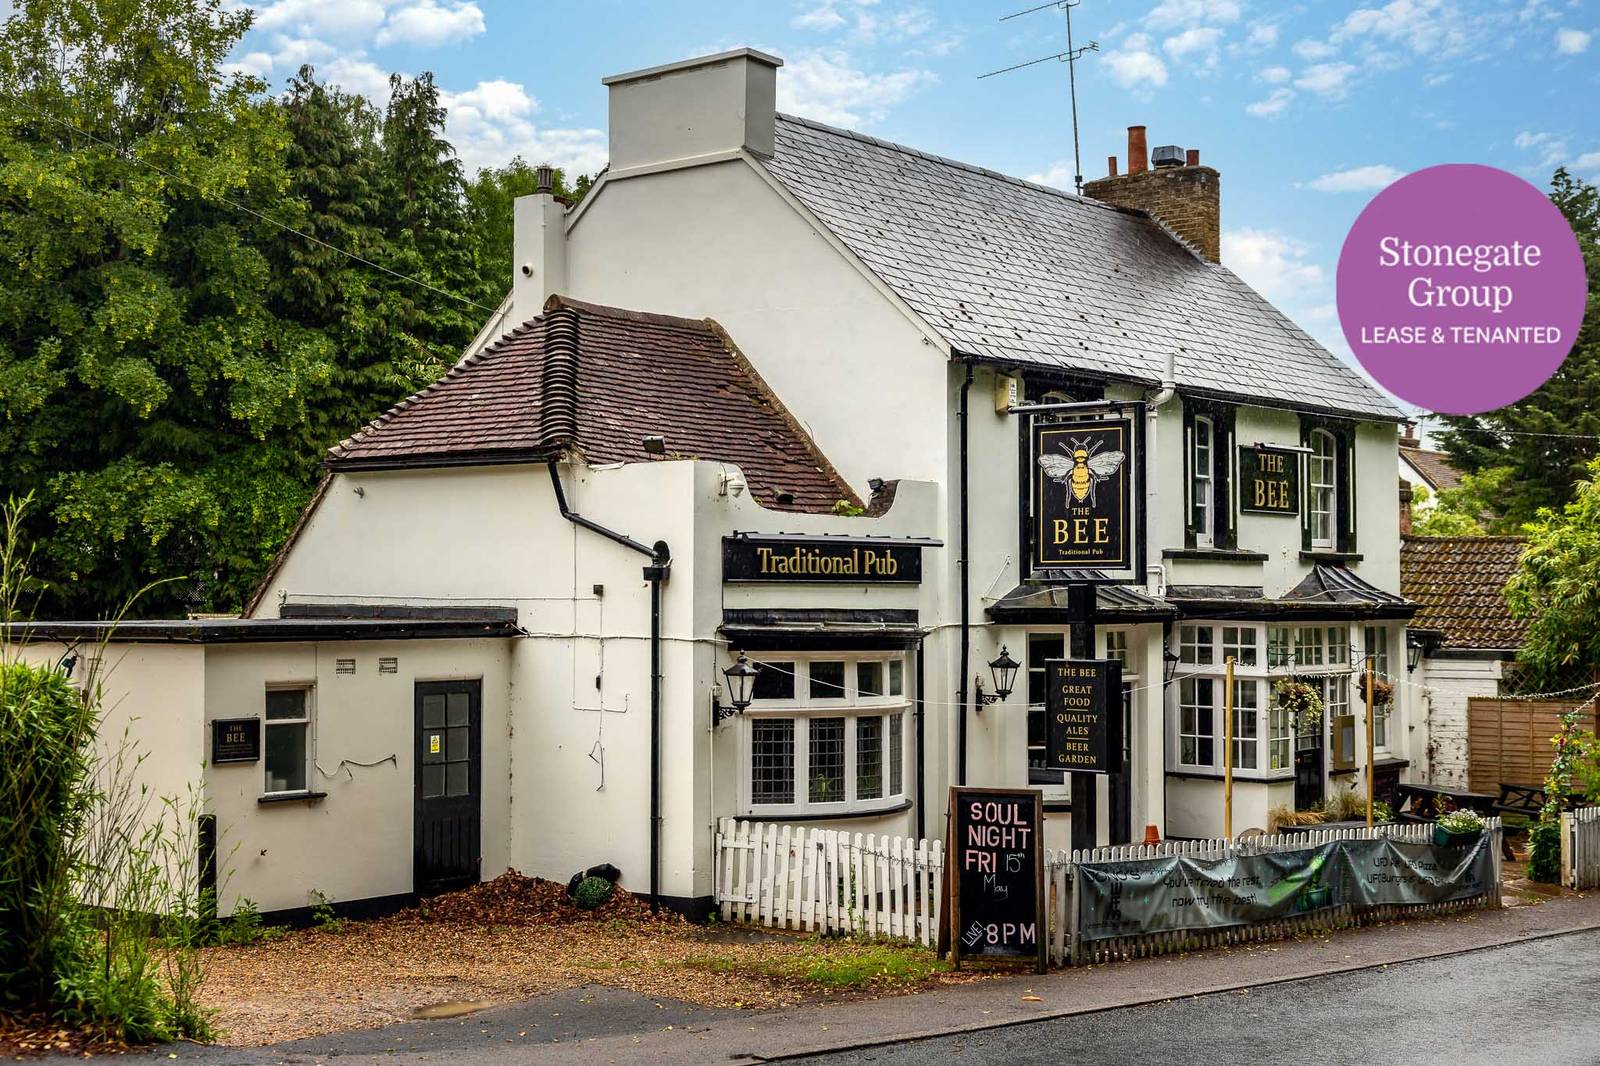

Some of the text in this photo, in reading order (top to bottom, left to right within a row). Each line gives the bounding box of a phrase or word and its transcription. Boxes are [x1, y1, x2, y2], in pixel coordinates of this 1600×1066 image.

[1258, 453, 1284, 473] THE
[1254, 479, 1290, 509] BEE
[1071, 507, 1090, 516] THE
[1052, 518, 1109, 544] BEE
[757, 546, 898, 576] Traditional Pub
[1057, 668, 1097, 678] THE BEE
[1062, 685, 1092, 695] GREAT
[1064, 697, 1091, 707] FOOD
[1056, 713, 1098, 723] QUALITY
[229, 724, 244, 732] THE
[1066, 726, 1089, 735] ALES
[226, 733, 246, 743] BEE
[1066, 743, 1089, 752] BEER
[1058, 754, 1097, 764] GARDEN
[970, 802, 1027, 826] SOUL
[968, 825, 1031, 850] NIGHT
[965, 849, 997, 873] FRI
[984, 873, 1009, 899] May
[1172, 896, 1195, 908] now
[961, 920, 984, 946] LIVE!
